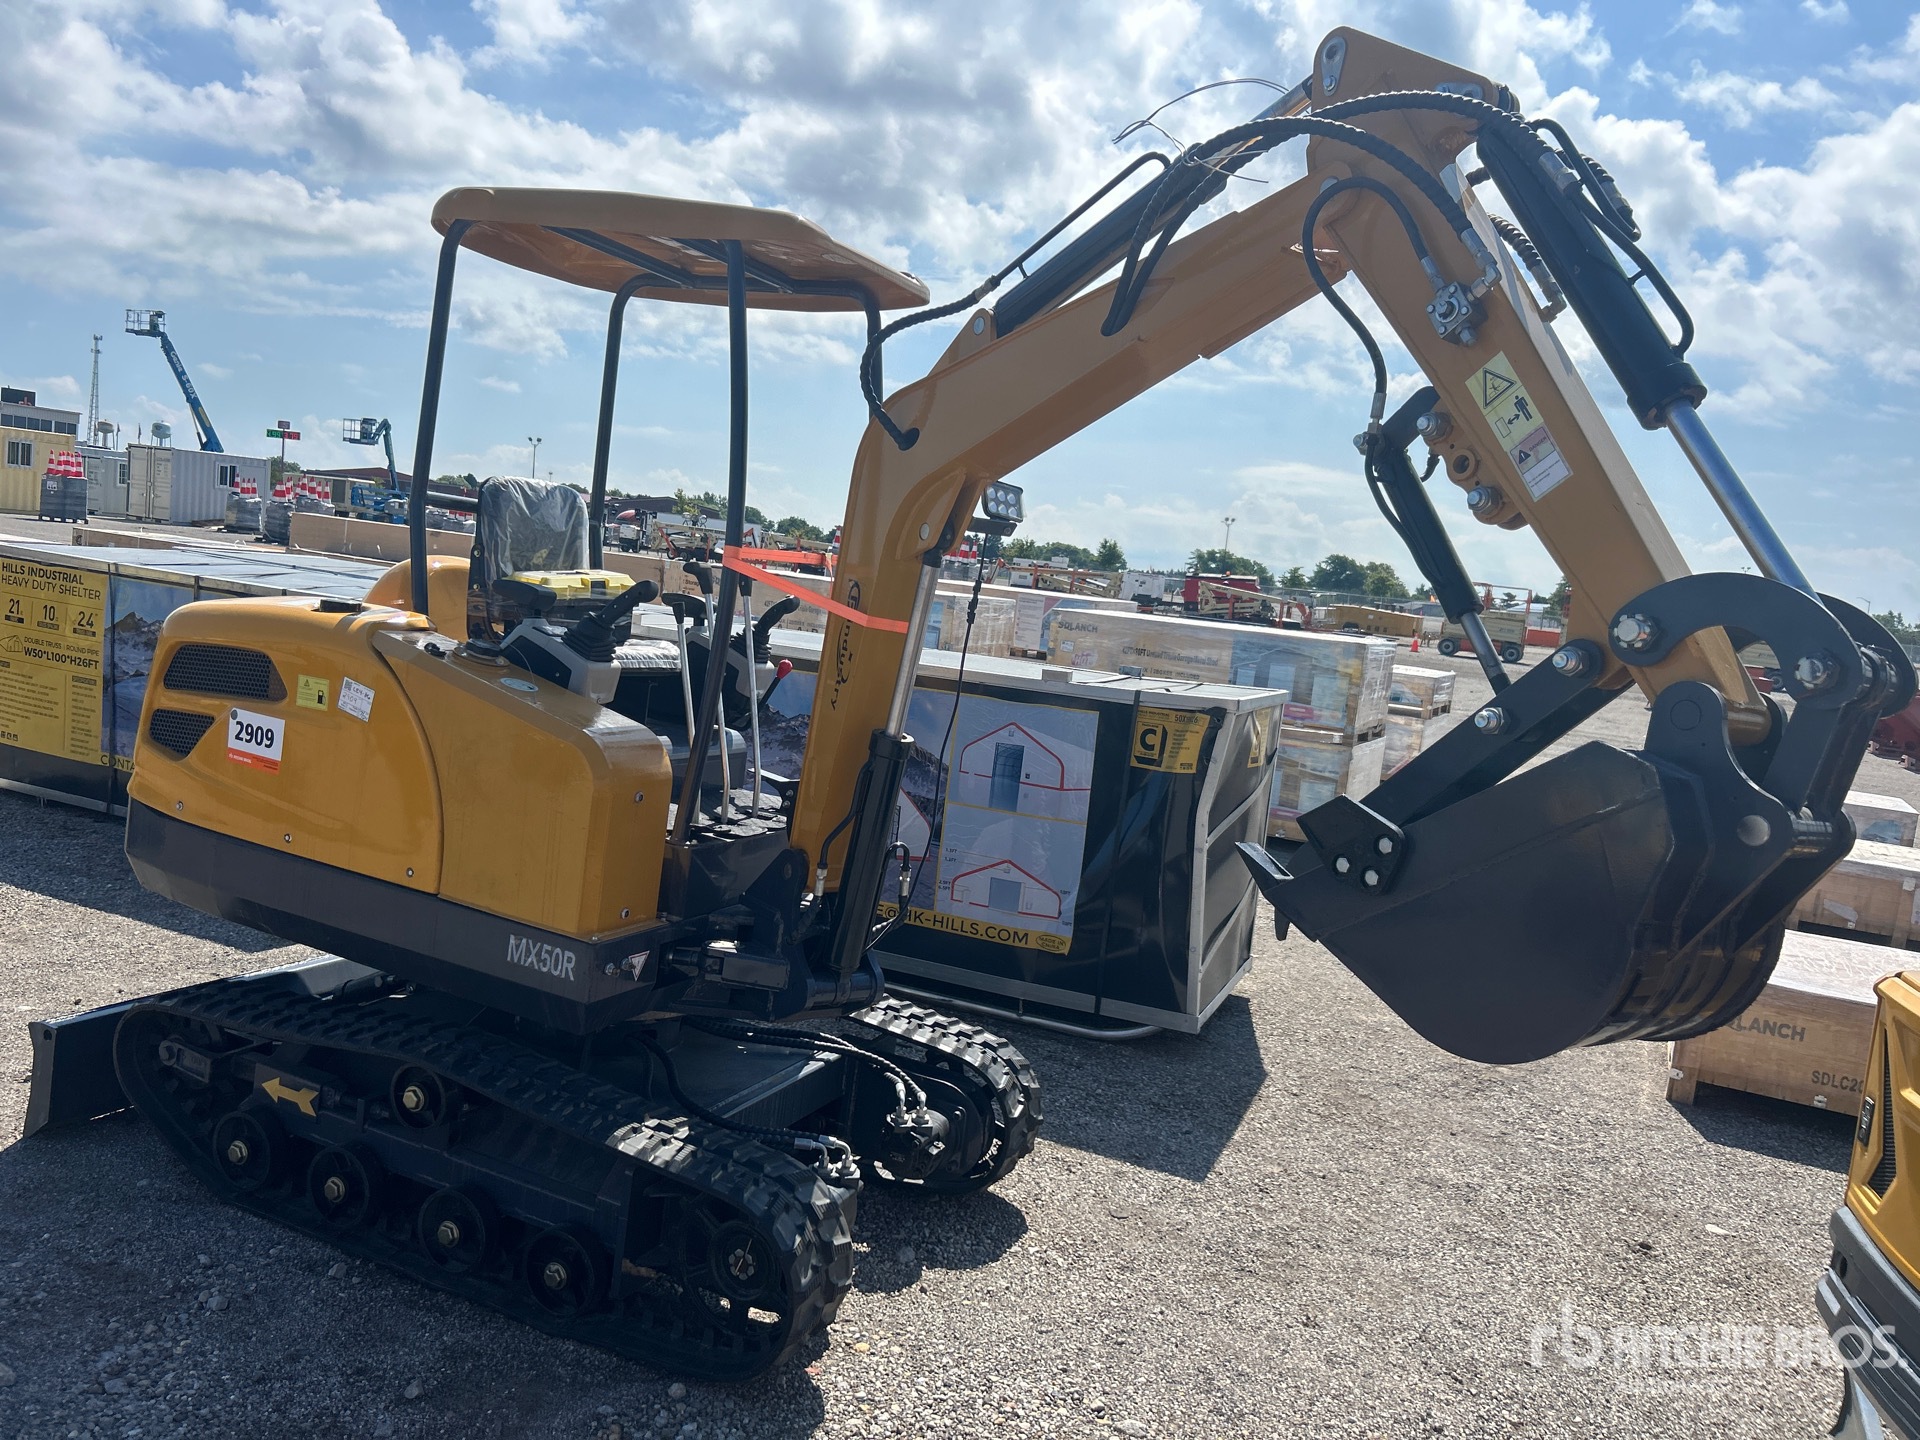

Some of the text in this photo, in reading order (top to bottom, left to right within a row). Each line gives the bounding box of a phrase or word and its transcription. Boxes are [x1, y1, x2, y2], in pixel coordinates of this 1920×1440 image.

[2, 562, 84, 585] HILLS INDUSTRIAL
[1, 574, 101, 601] HEAVY DUTY SHELTER
[9, 598, 20, 615] 21
[43, 604, 56, 621] 10
[78, 610, 94, 629] 24
[24, 636, 100, 657] DOUBLE TRUSS ROUND PIPE
[831, 619, 852, 711] ndustry
[234, 720, 275, 749] 2909
[1140, 728, 1157, 752] C
[506, 934, 576, 982] MX50R
